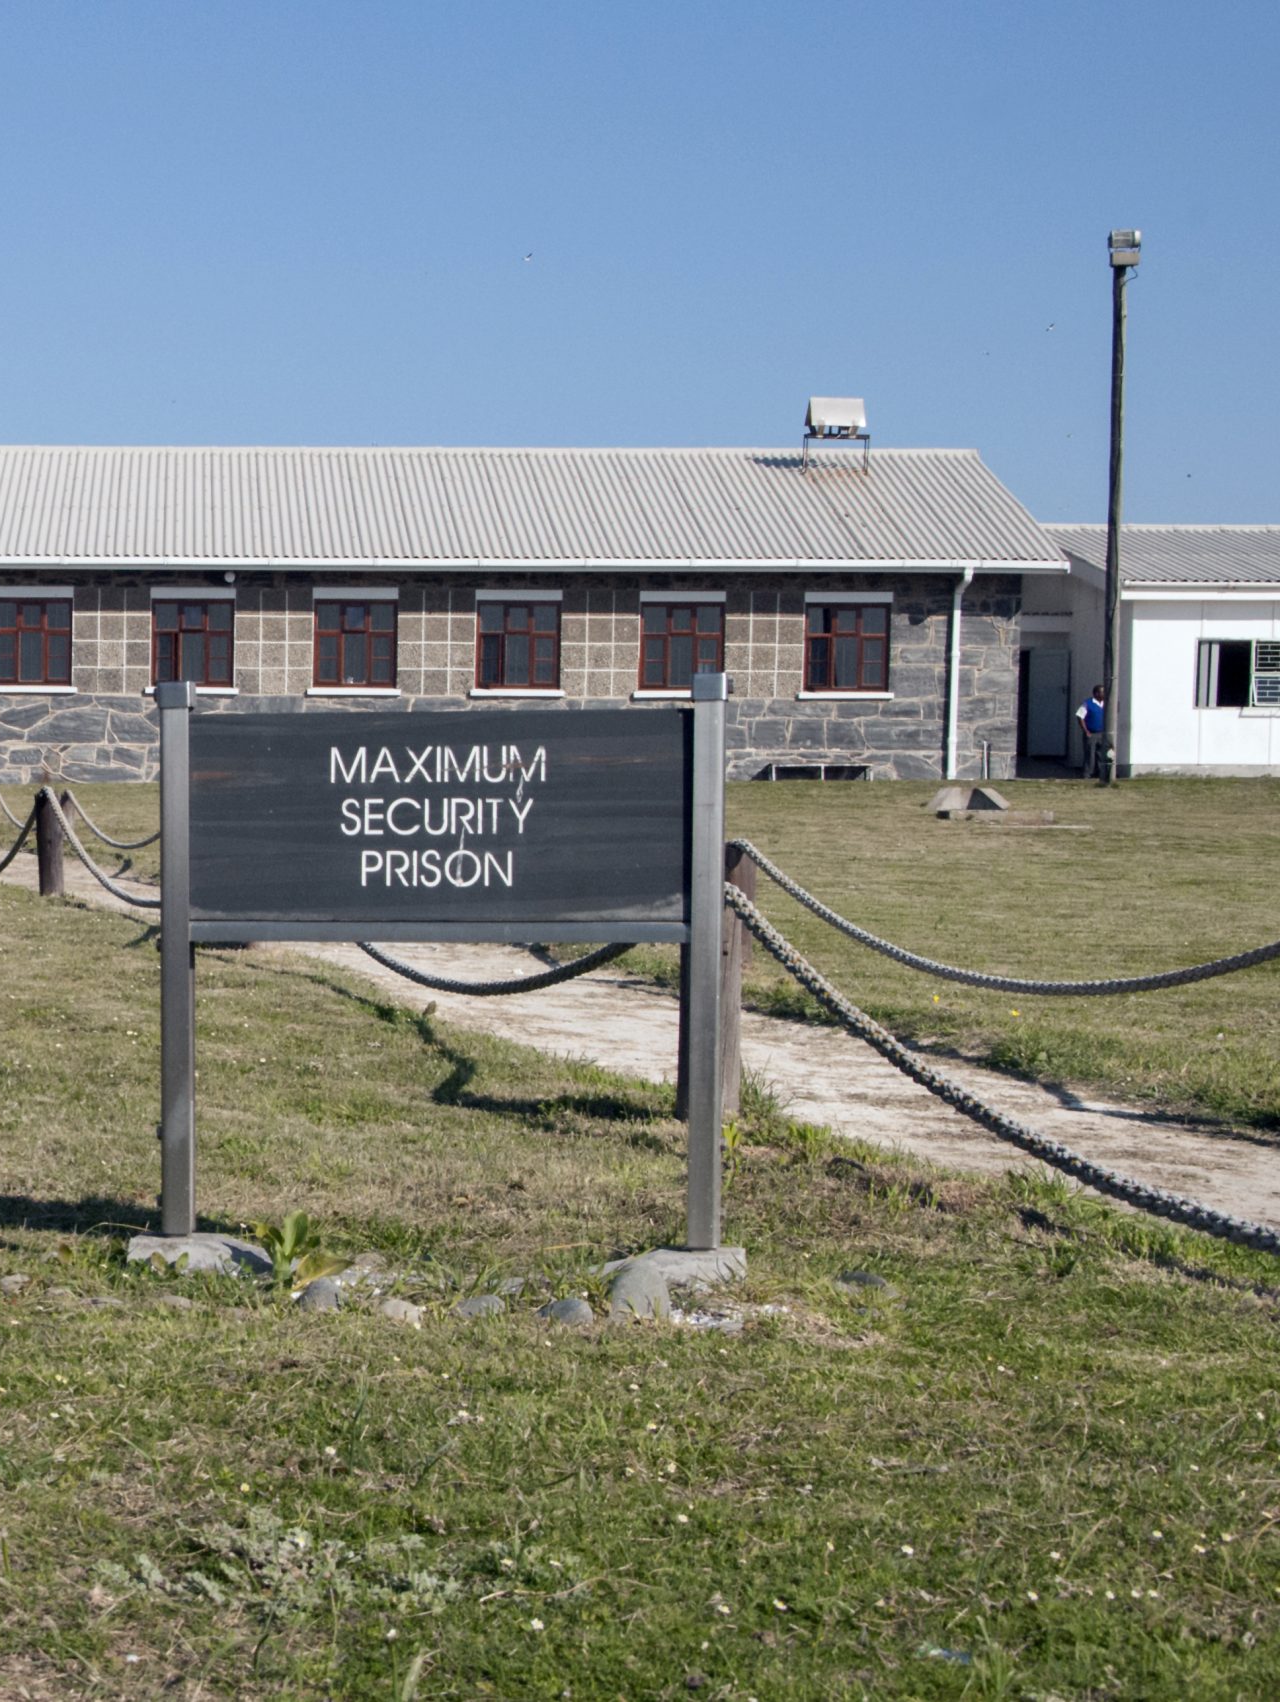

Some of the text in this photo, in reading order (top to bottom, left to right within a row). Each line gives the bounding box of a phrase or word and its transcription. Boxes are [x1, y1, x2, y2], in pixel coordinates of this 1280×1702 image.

[330, 745, 547, 784] MAXIMUM
[340, 797, 534, 836] SECURITY
[360, 849, 513, 888] PRISON
